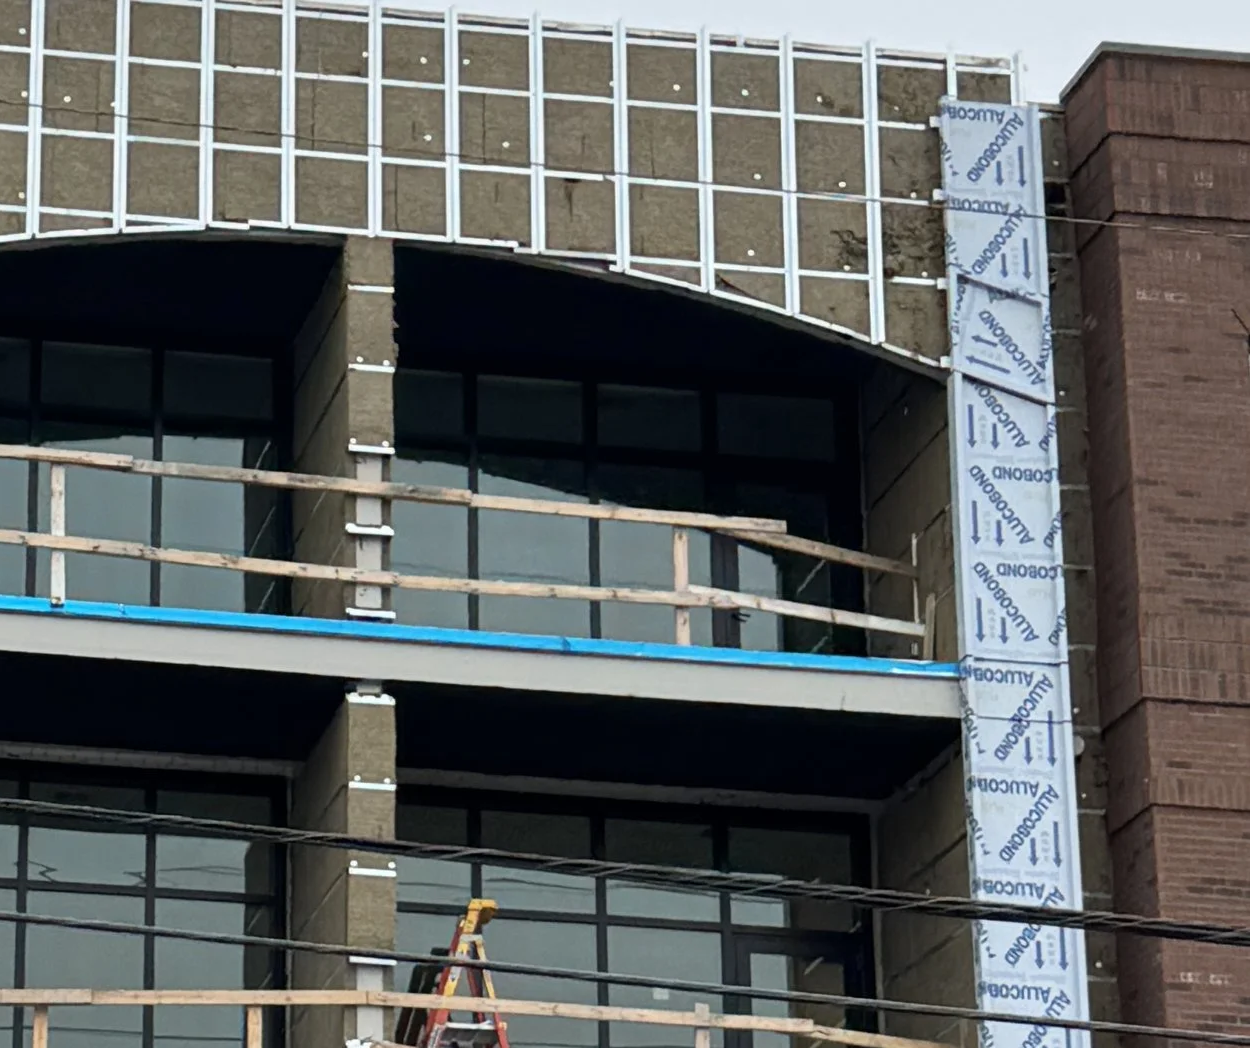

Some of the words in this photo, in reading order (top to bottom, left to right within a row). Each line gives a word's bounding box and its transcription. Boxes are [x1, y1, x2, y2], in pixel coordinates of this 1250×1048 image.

[943, 105, 1005, 124] ALUCOB
[967, 111, 1025, 182] ALUCOBOND
[978, 310, 1046, 386] ALUCOBOND
[969, 464, 1035, 546] ALUCOBOND
[973, 561, 1040, 644] ALUCOBOND
[999, 783, 1060, 863] ALUCOBOND
